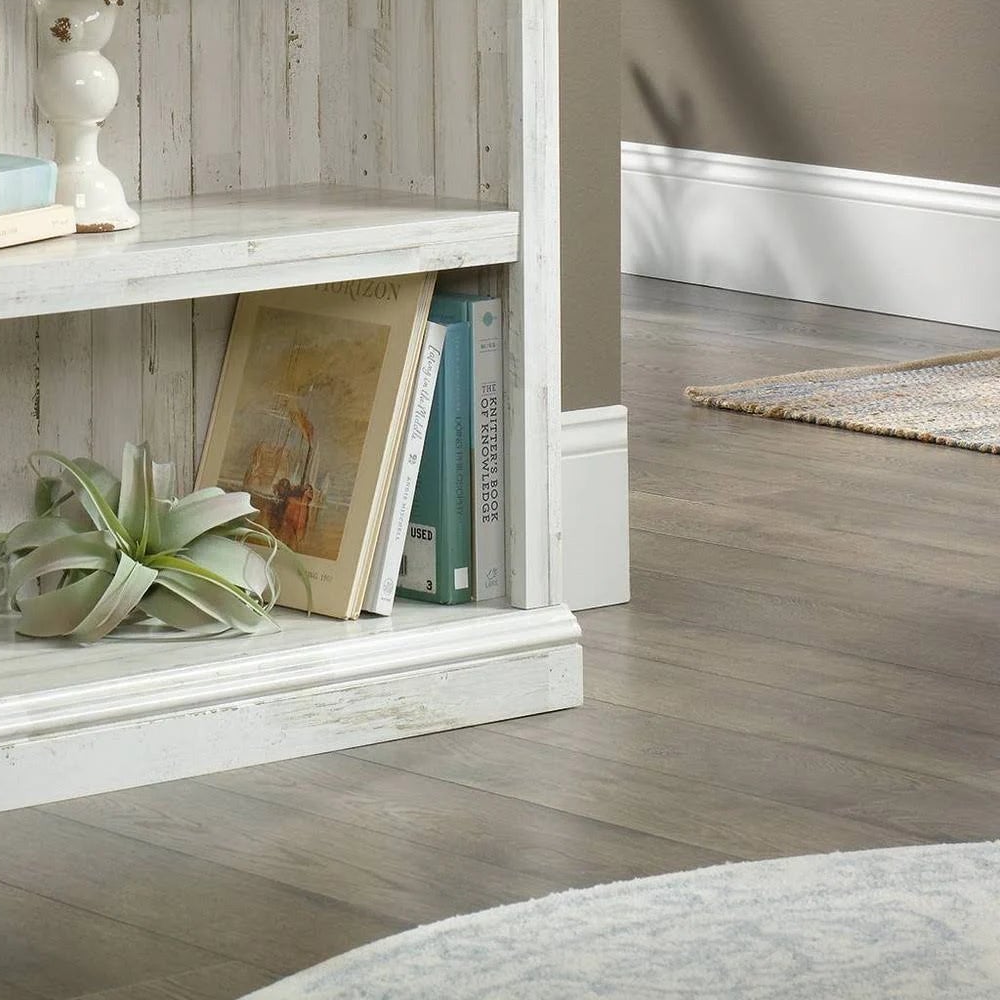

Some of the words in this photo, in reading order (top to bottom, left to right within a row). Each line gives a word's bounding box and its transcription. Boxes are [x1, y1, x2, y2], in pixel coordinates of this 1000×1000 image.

[411, 404, 426, 440] Middle
[481, 398, 489, 418] OF
[482, 383, 496, 393] THE
[490, 397, 498, 473] KNITTER'S
[481, 424, 491, 523] KNOWLEDGE
[411, 527, 433, 541] USED
[426, 580, 433, 590] 3
